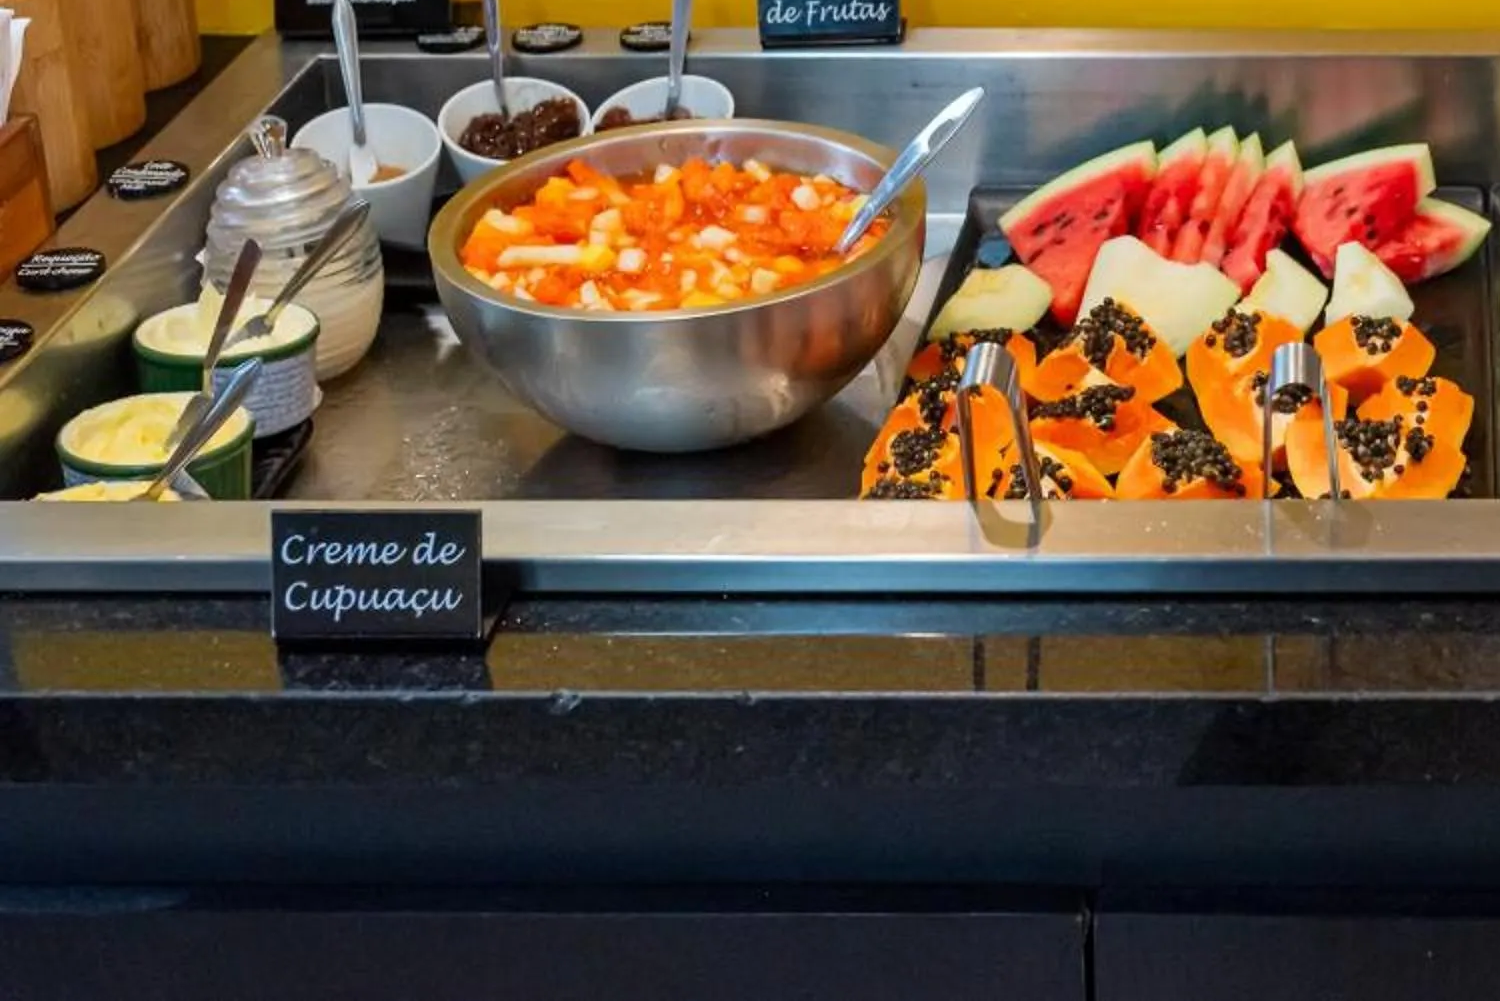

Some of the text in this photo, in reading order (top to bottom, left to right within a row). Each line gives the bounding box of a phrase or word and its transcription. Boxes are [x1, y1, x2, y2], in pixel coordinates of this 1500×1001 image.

[766, 0, 892, 27] de Frutas
[281, 531, 466, 566] Creme de
[285, 581, 463, 623] Cupuaçu
